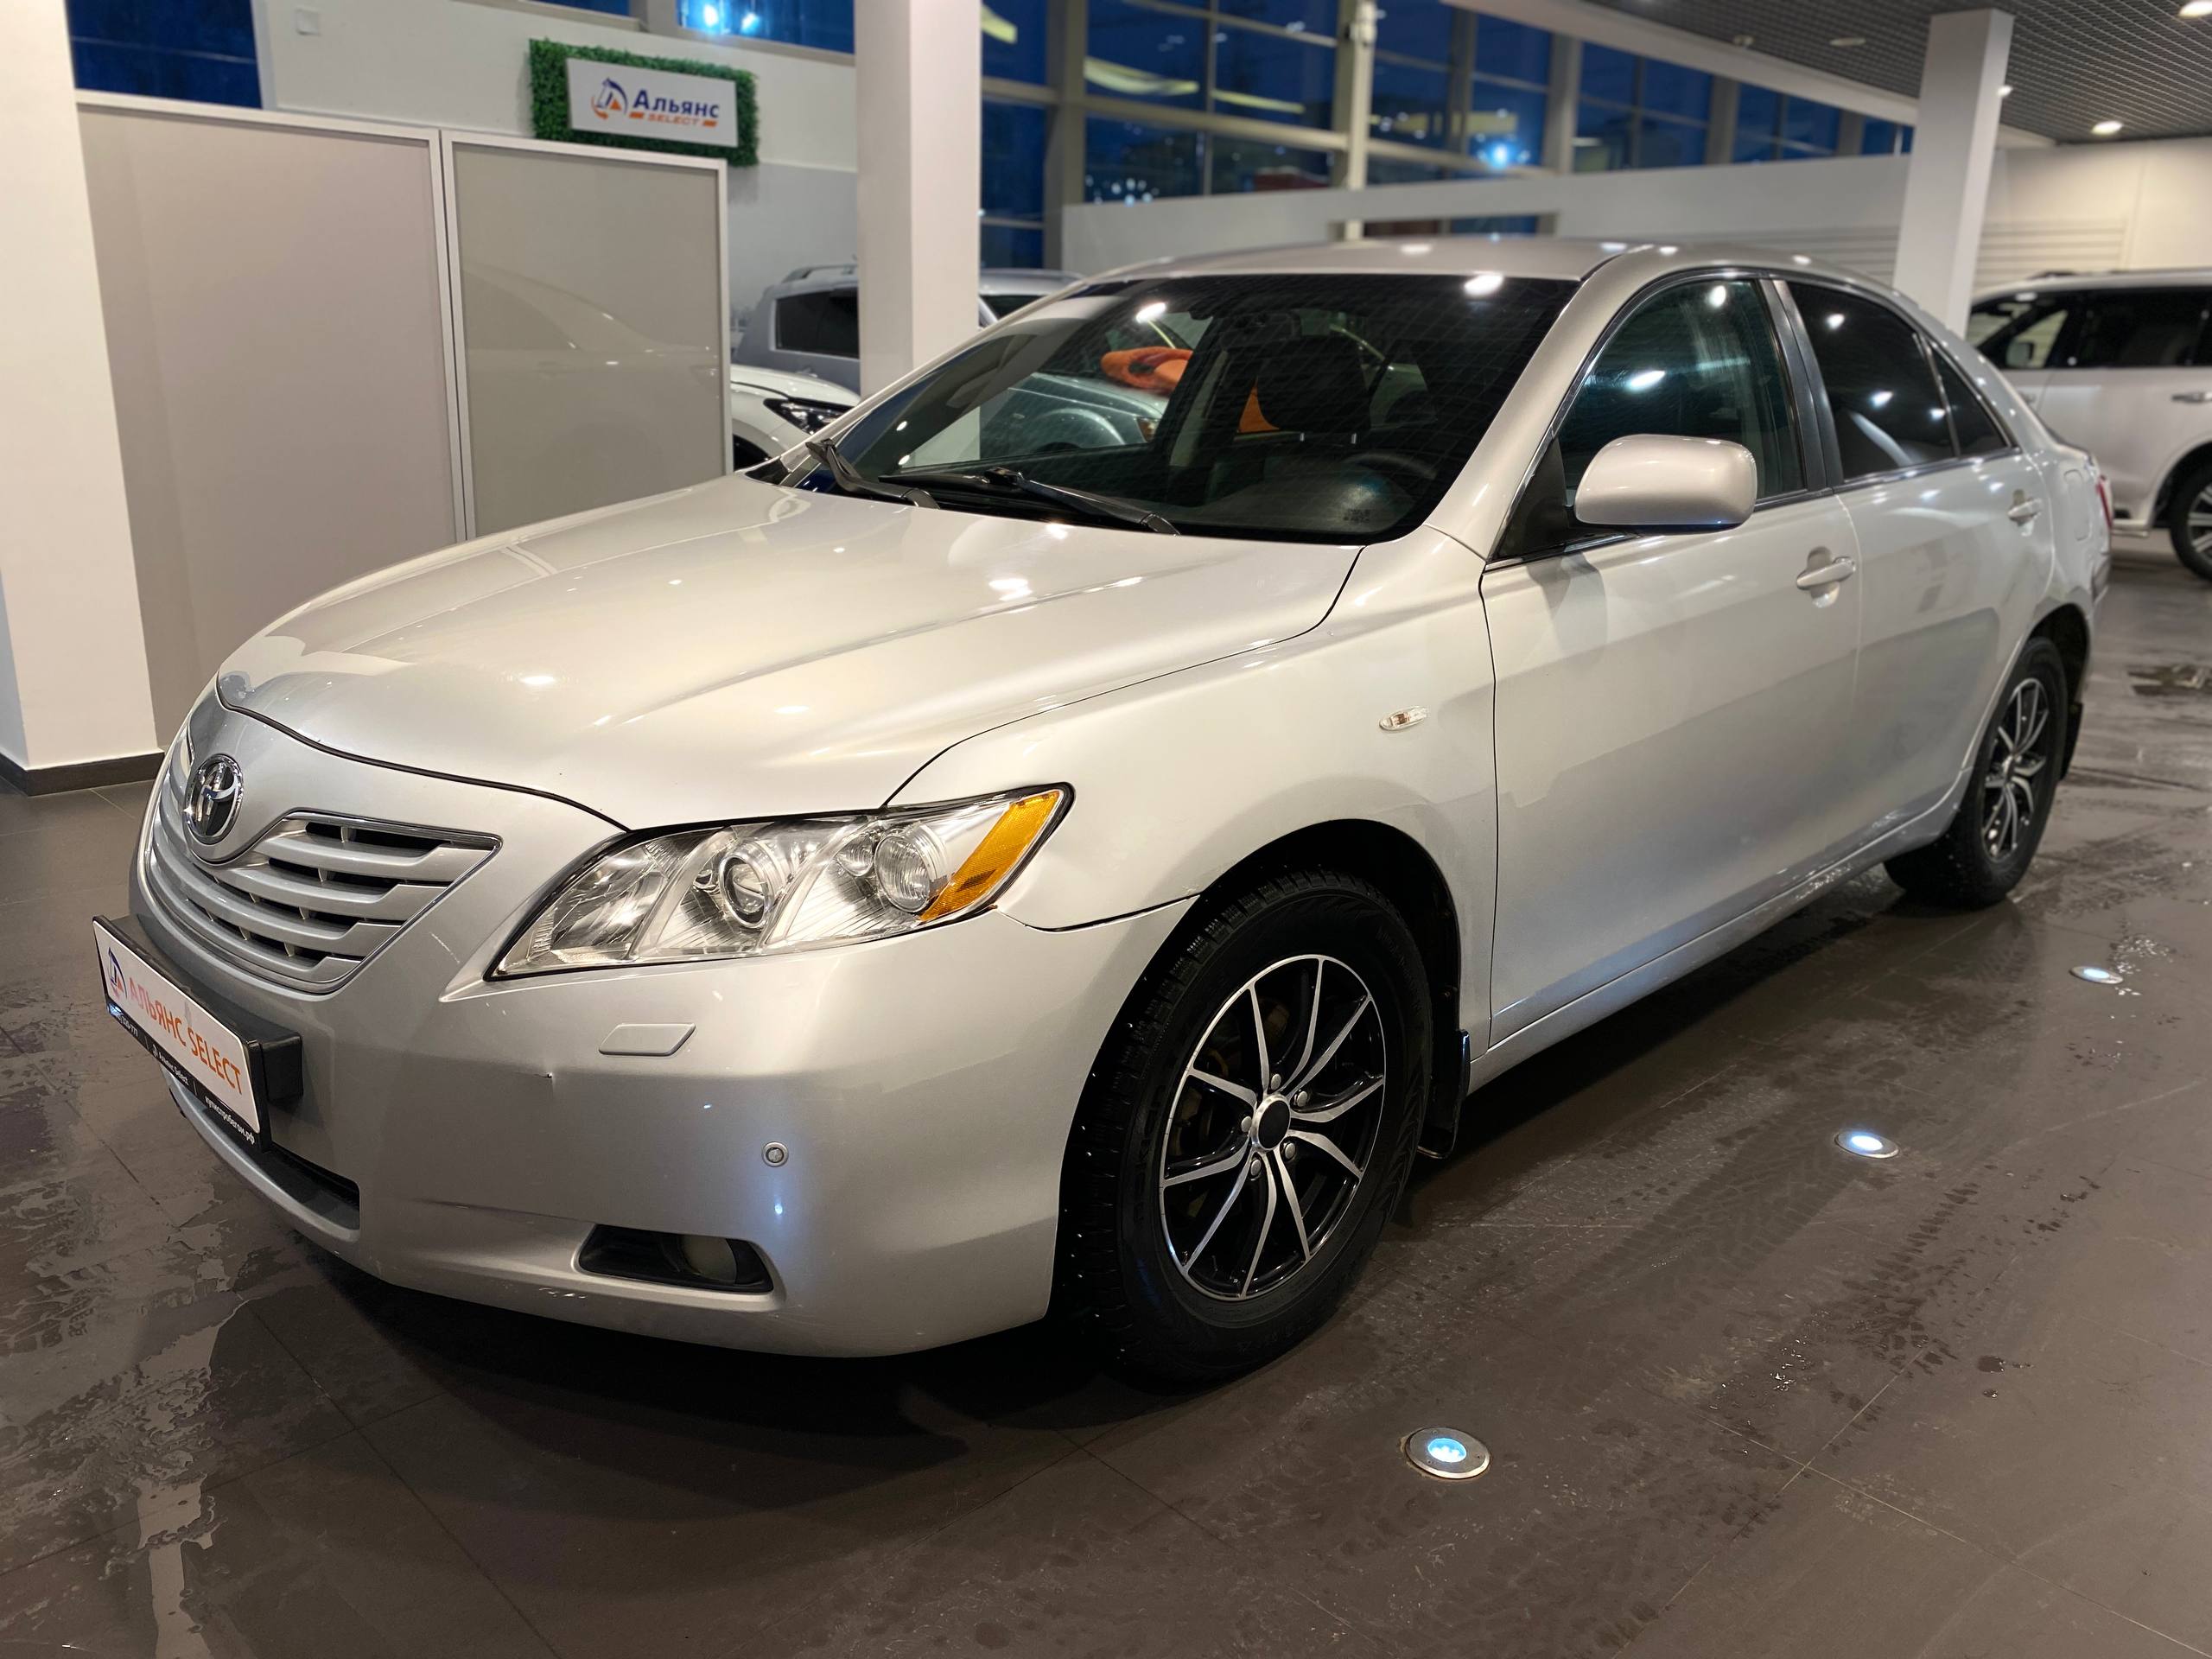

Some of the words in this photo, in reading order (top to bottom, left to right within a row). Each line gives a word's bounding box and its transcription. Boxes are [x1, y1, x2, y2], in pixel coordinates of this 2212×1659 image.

[632, 89, 720, 118] Альянс
[646, 112, 701, 126] SELECT
[128, 976, 186, 1046] АЛЬЯНС
[188, 1027, 242, 1096] SELECT
